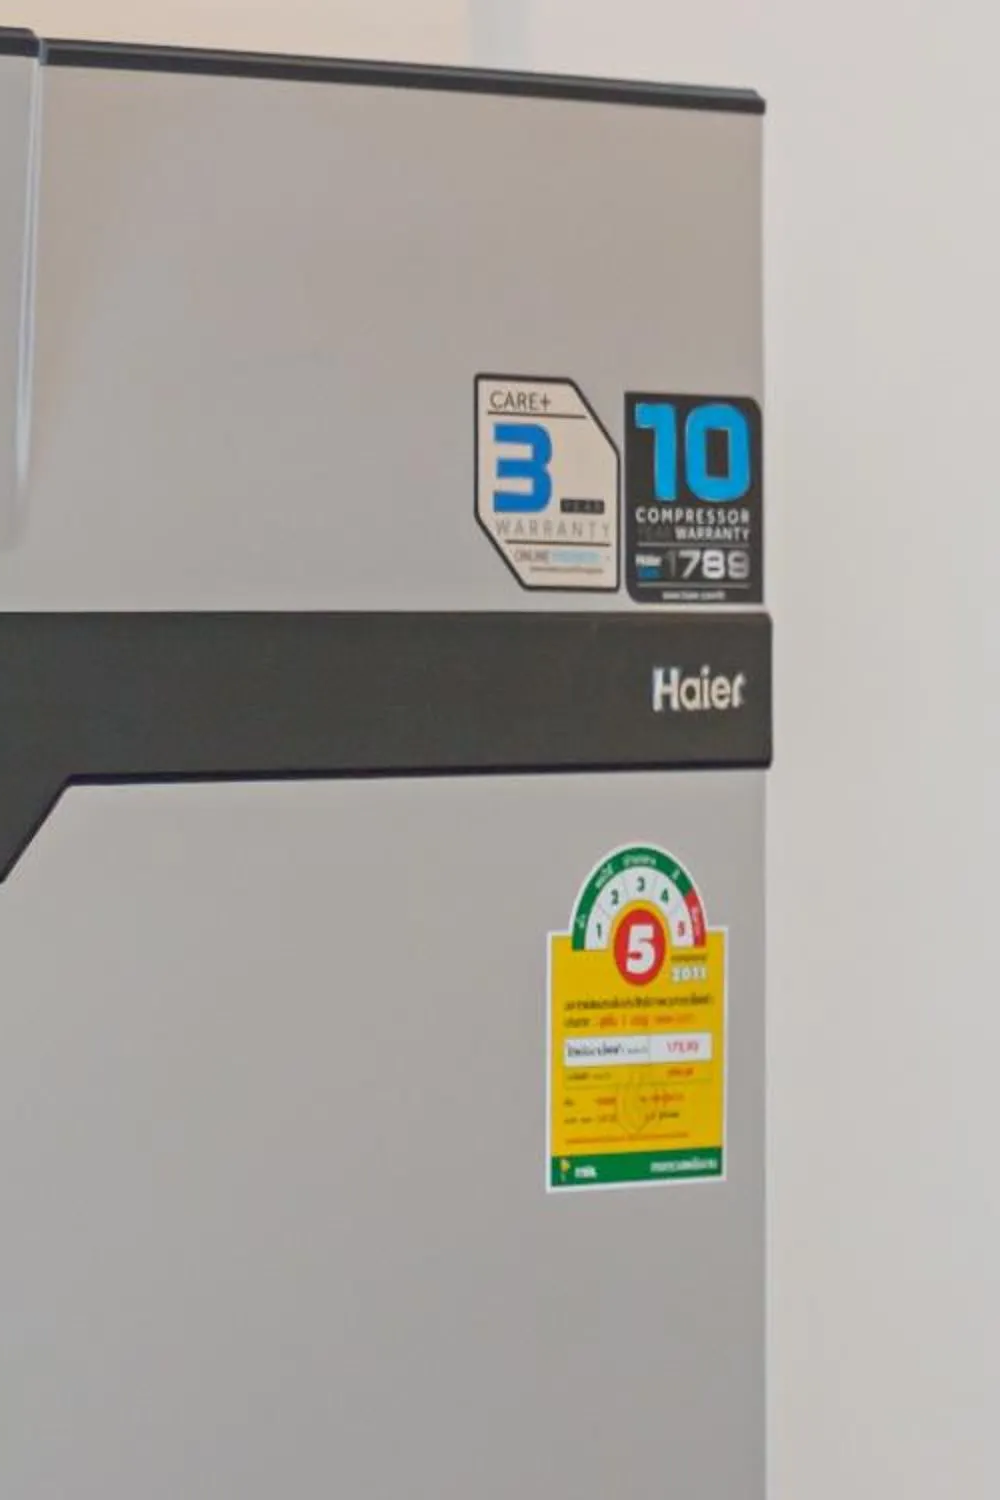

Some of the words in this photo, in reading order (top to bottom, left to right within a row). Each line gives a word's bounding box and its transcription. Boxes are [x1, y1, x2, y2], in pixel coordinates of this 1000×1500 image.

[489, 389, 552, 412] CARE+
[492, 422, 553, 513] 3
[634, 402, 751, 502] 10
[495, 519, 611, 539] WARRANTY
[635, 506, 750, 525] COMPRESSOR
[675, 526, 751, 542] WARRANTY
[652, 664, 746, 712] Haier
[595, 922, 603, 939] 1
[611, 888, 620, 906] 2
[636, 876, 647, 893] 3
[660, 888, 670, 904] 4
[625, 923, 656, 975] 5
